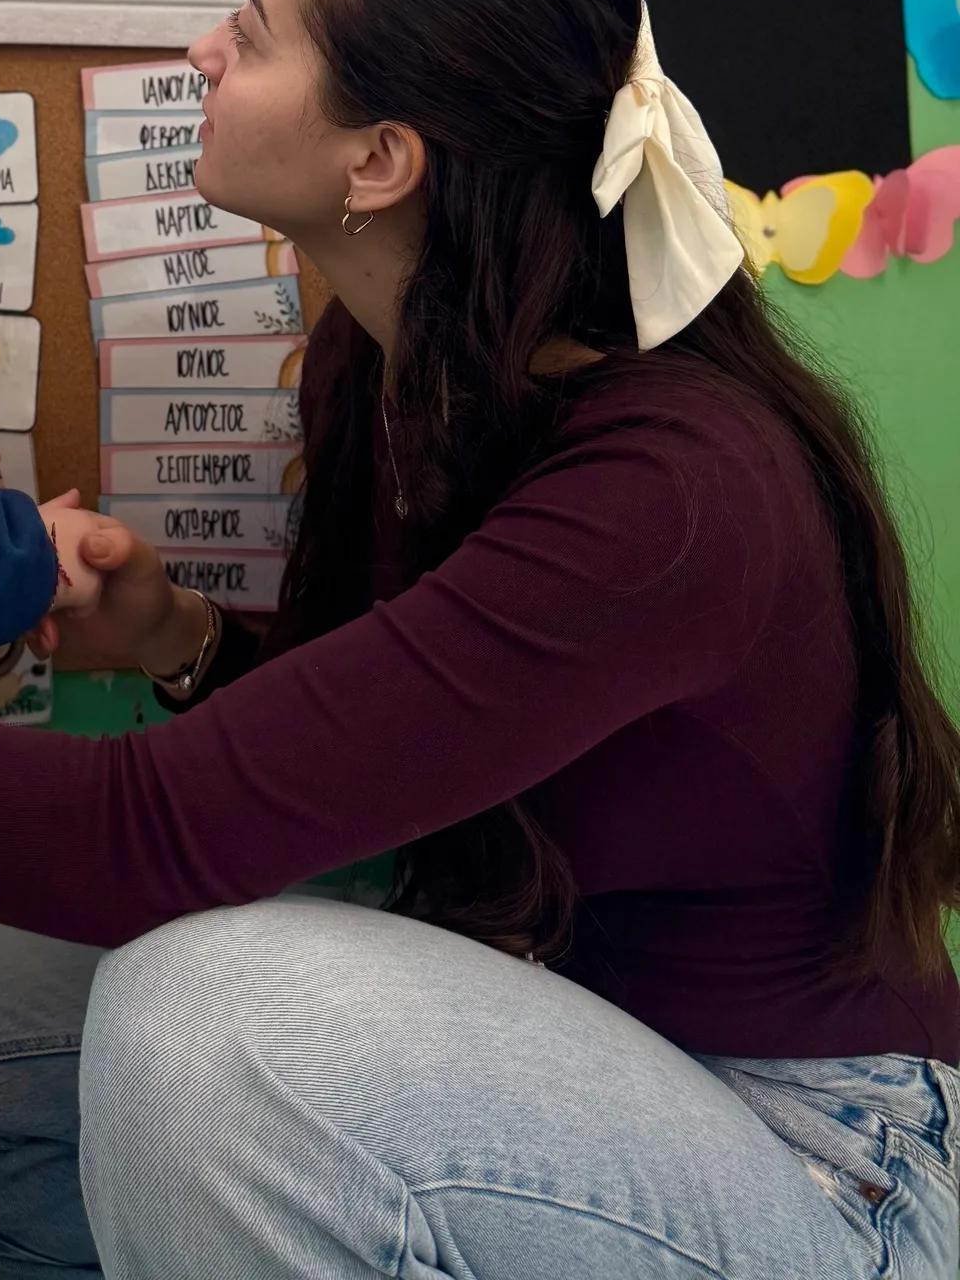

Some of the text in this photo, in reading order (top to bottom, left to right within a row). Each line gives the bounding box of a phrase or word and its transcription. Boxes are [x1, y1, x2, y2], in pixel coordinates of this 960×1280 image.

[139, 123, 201, 150] ΦΕΒΡΟΥ
[145, 158, 198, 192] ΔΕΚΕΜ
[155, 203, 218, 237] ΜΑΡΤΙΟΣ
[166, 299, 225, 333] ΙΟΥΝΙΟΣ
[176, 347, 230, 379] ΙΟΥΛΙΟΣ
[164, 401, 248, 436] ΑΥΓΟΥΣΤΟΣ
[155, 453, 256, 487] ΣΕΠΤΕΜΒΡΙΟΣ
